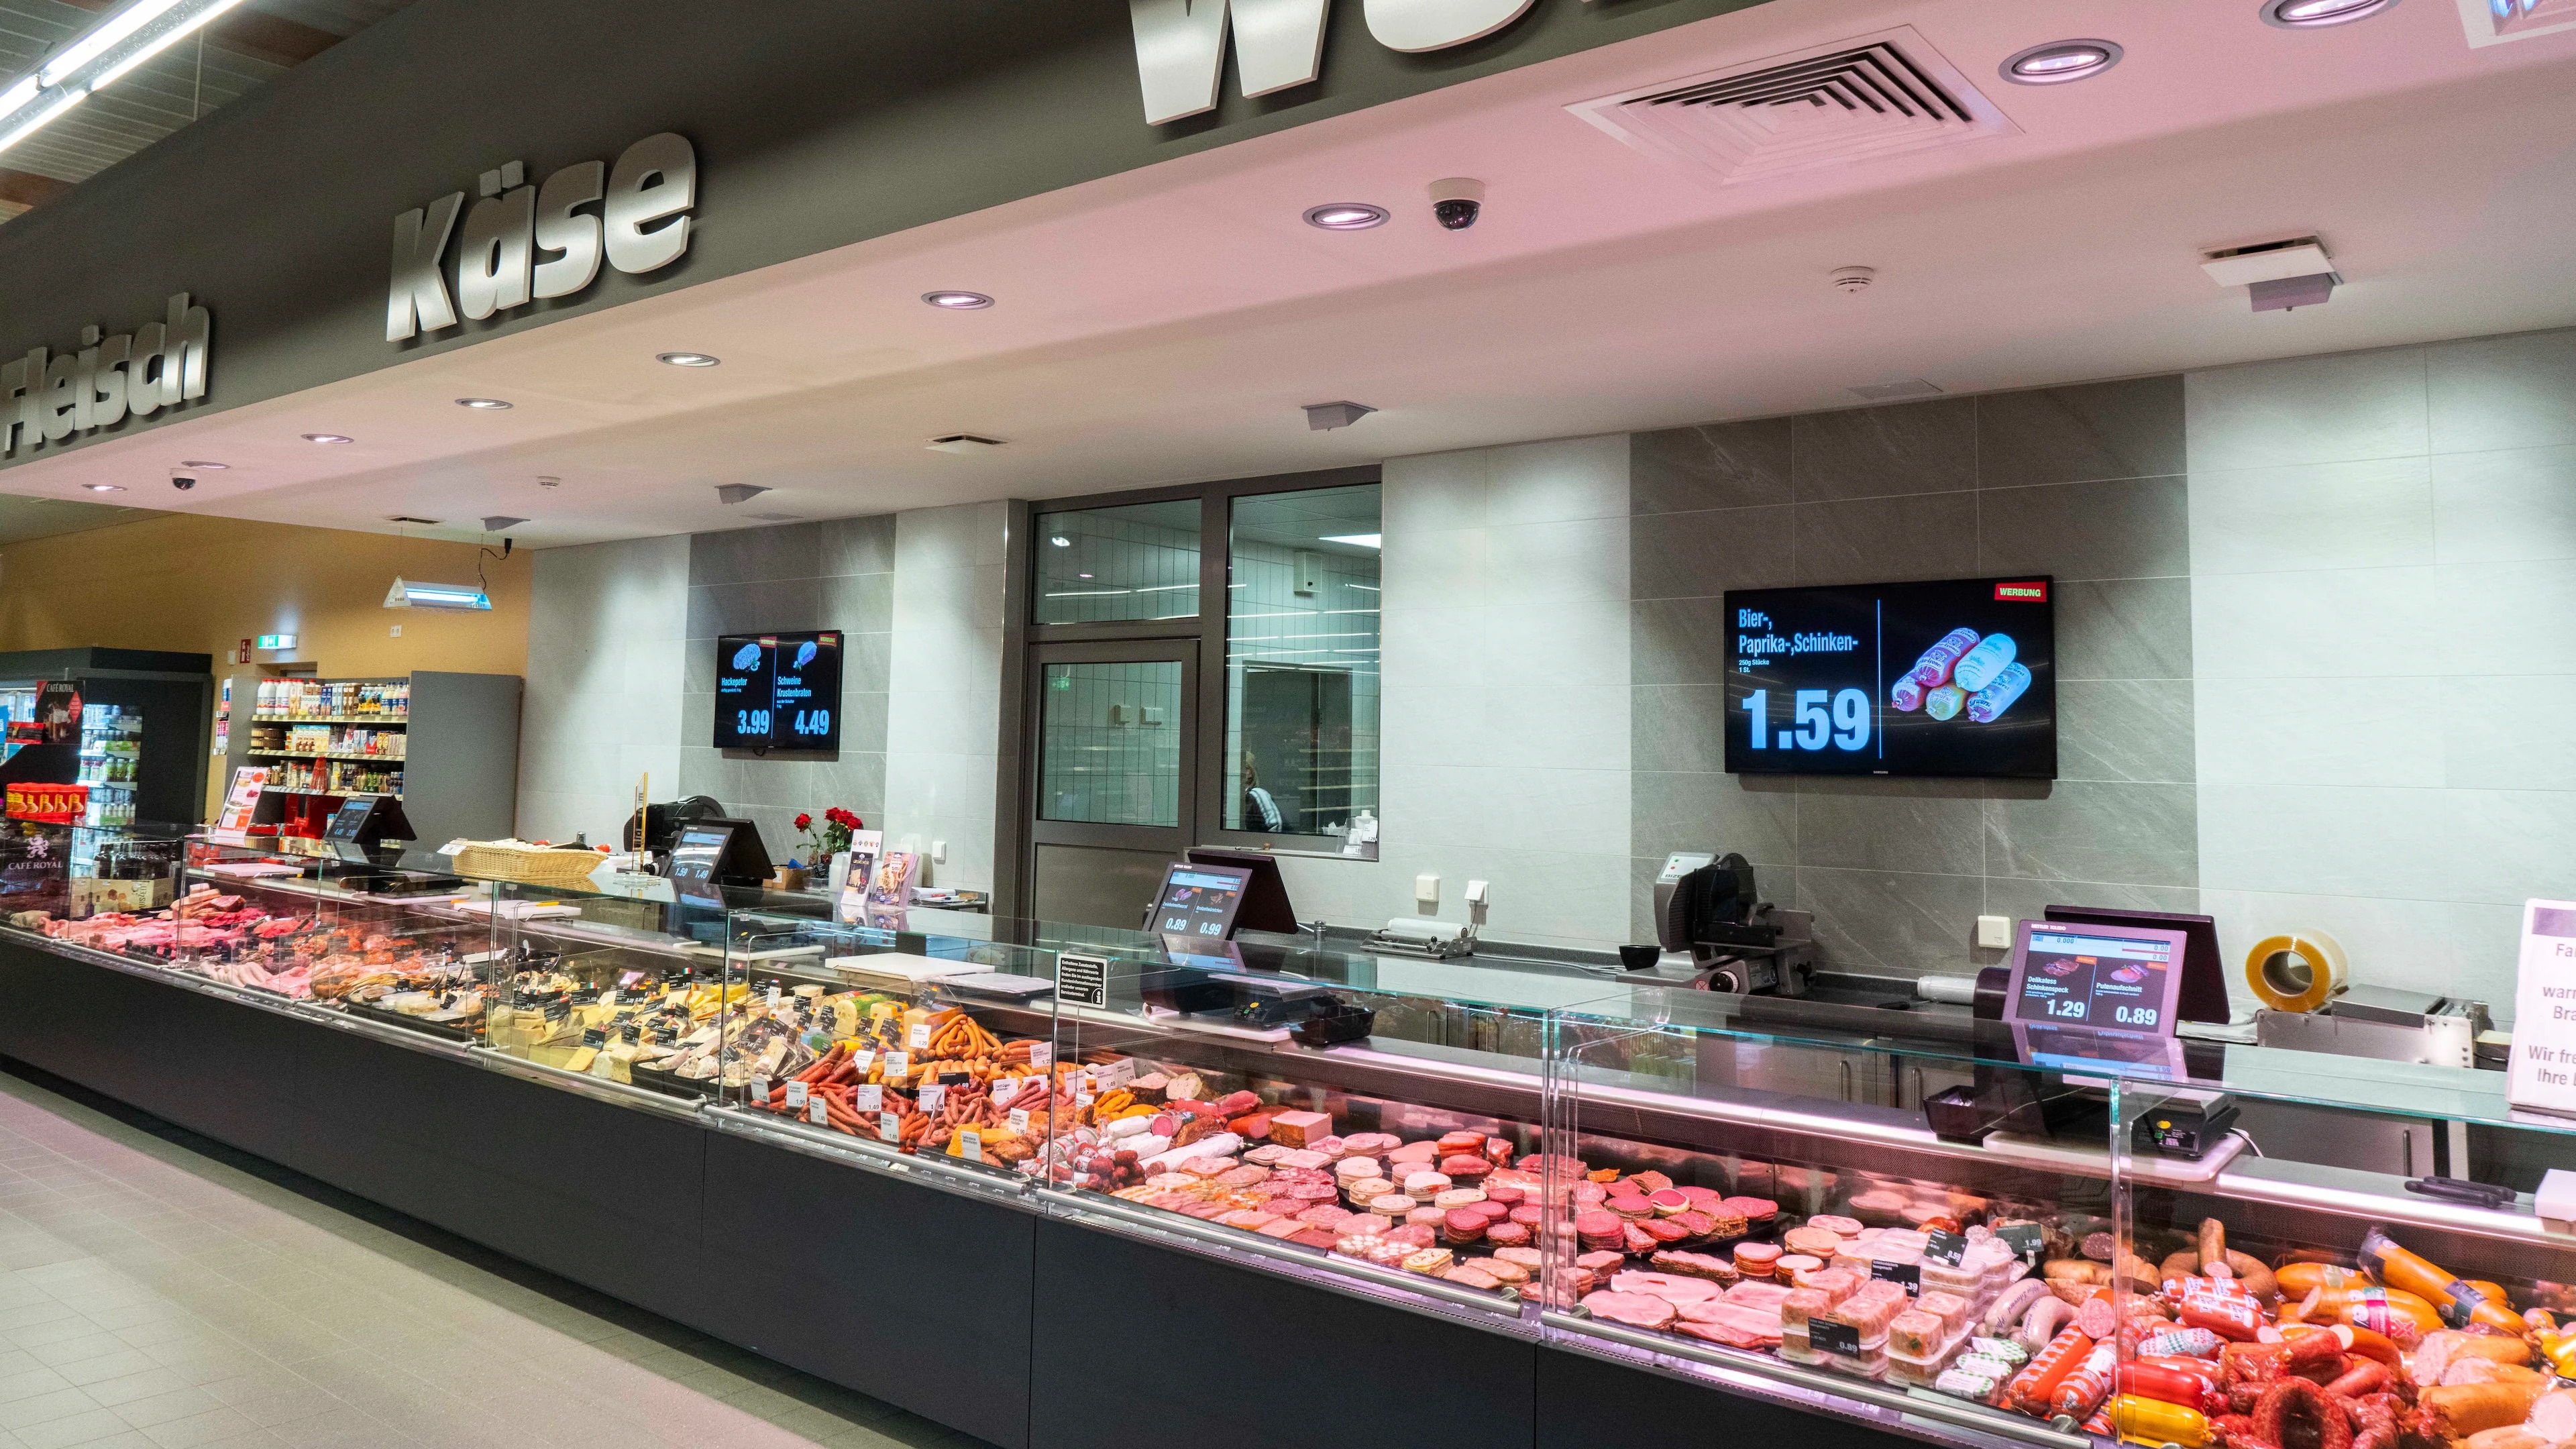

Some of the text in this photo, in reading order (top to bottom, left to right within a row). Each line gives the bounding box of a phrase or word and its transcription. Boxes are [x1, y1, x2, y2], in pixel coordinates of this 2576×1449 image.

[386, 132, 696, 341] Käse
[1, 291, 210, 451] Fleisch
[2000, 588, 2041, 597] WERBUNG
[722, 678, 747, 687] Hackepeter
[777, 676, 801, 685] Schweine
[777, 688, 811, 697] Krustenbraten
[737, 710, 769, 735] 3.99
[795, 710, 830, 735] 4.49
[1742, 689, 1870, 751] 1.59
[675, 867, 688, 877] 1.59
[1165, 918, 1187, 931] 0.89
[1200, 922, 1222, 935] 0.99
[2027, 976, 2057, 985] Delikatess
[2026, 983, 2069, 994] Schinkenspeck
[2096, 983, 2143, 993] Putenaufschnitt
[2047, 999, 2085, 1018] 1.29
[2116, 1006, 2157, 1026] 0.89
[2528, 1044, 2555, 1061] Wir
[2537, 1068, 2567, 1085] Ihre
[1947, 1250, 1962, 1261] 0.59
[1839, 1341, 1858, 1352] 0.89
